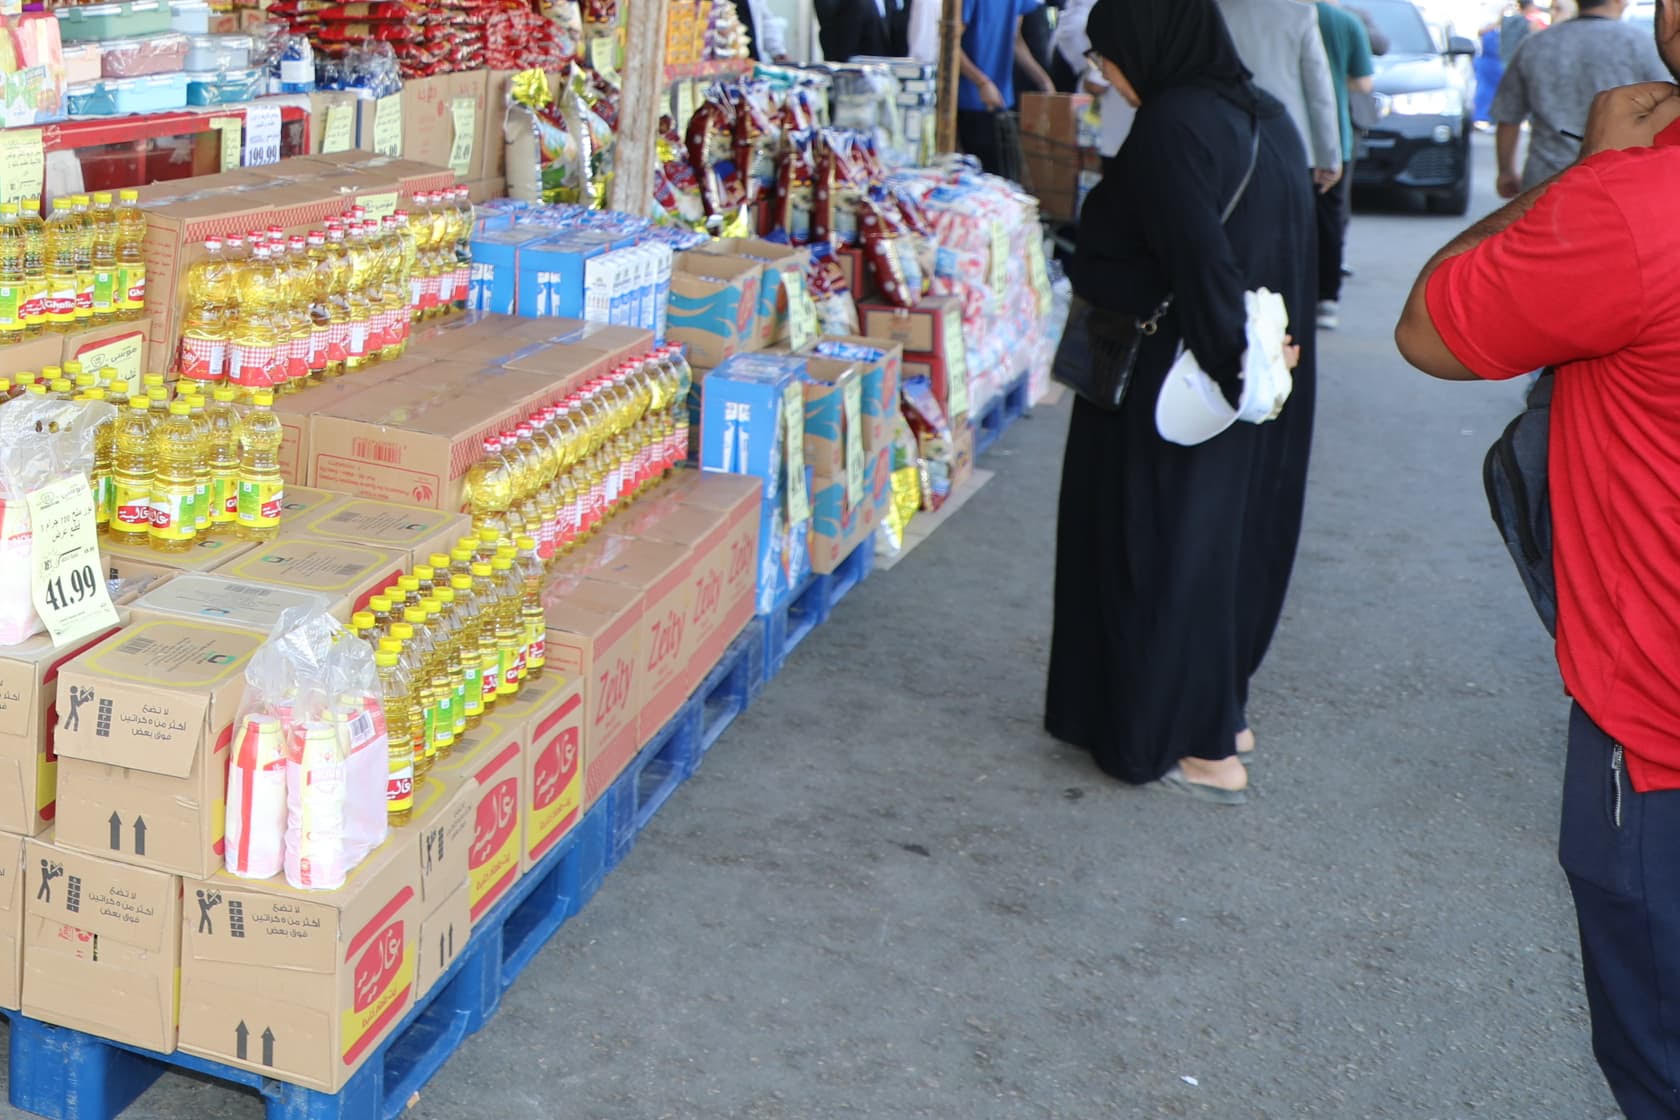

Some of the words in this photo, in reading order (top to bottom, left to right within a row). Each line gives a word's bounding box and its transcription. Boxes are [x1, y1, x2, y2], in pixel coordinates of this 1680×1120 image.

[45, 564, 97, 611] 41.99
[647, 610, 686, 672] Zeity
[4, 693, 20, 702] أكثر
[595, 656, 634, 726] Zeity
[120, 712, 148, 725] كراتين
[168, 721, 186, 732] أكثر
[536, 734, 577, 804] غالية
[88, 892, 115, 907] كراتين
[136, 906, 154, 916] أكثر
[252, 911, 280, 926] كراتين
[302, 918, 321, 928] أكثر
[358, 929, 401, 1004] غالية
